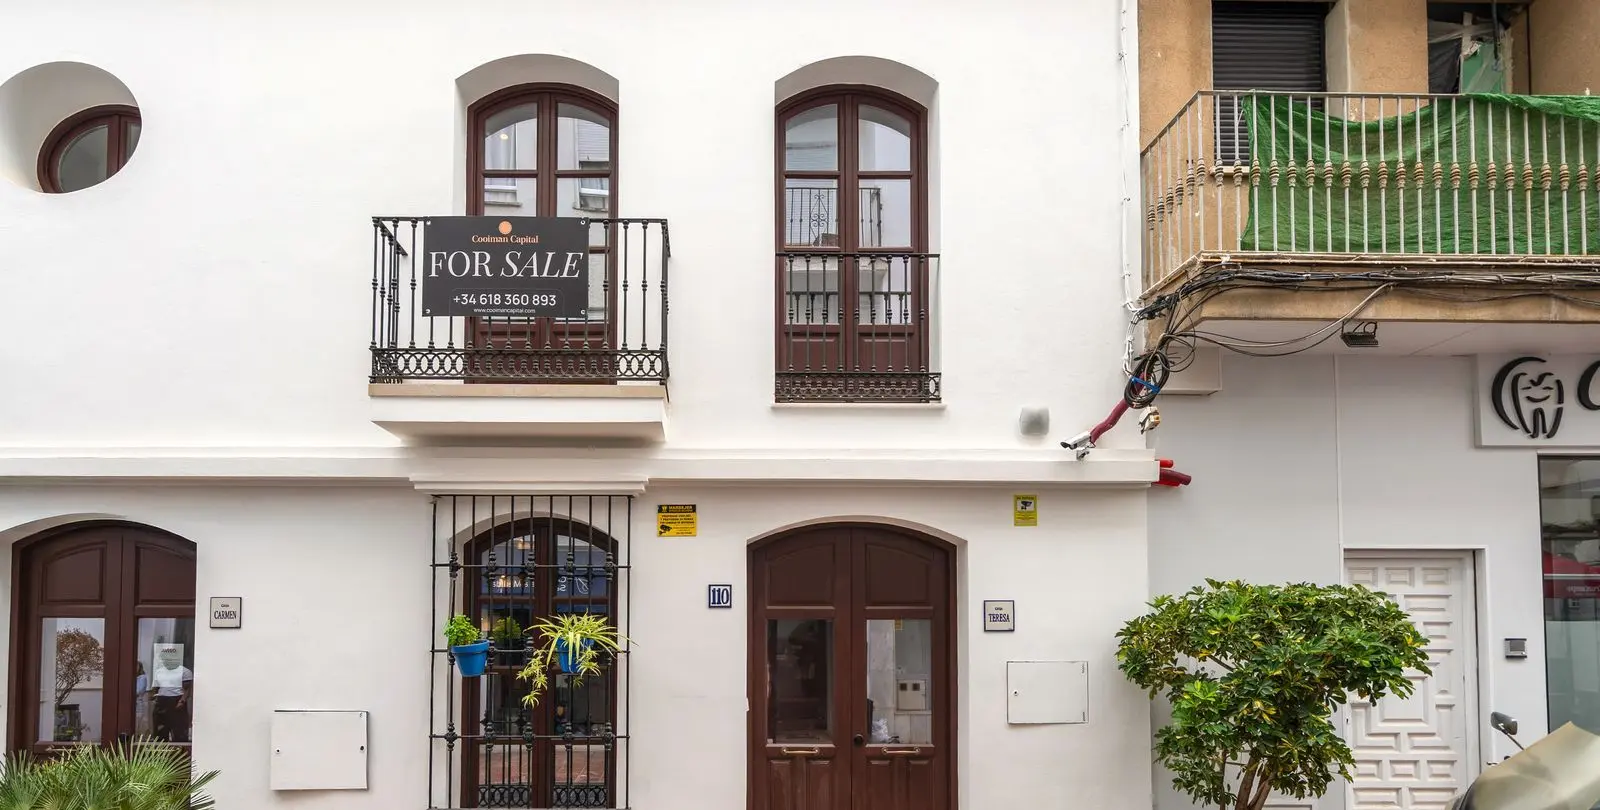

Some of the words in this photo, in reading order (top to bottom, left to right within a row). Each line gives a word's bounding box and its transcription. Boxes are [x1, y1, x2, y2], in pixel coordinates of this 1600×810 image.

[510, 235, 539, 245] Capital
[429, 251, 493, 277] FOR
[500, 251, 583, 278] SALE
[453, 294, 477, 305] +34
[479, 294, 501, 305] 618
[504, 294, 529, 306] 360
[532, 294, 556, 306] 893
[712, 588, 729, 604] 110
[214, 610, 237, 619] CARMEN
[988, 613, 1010, 622] TERESA
